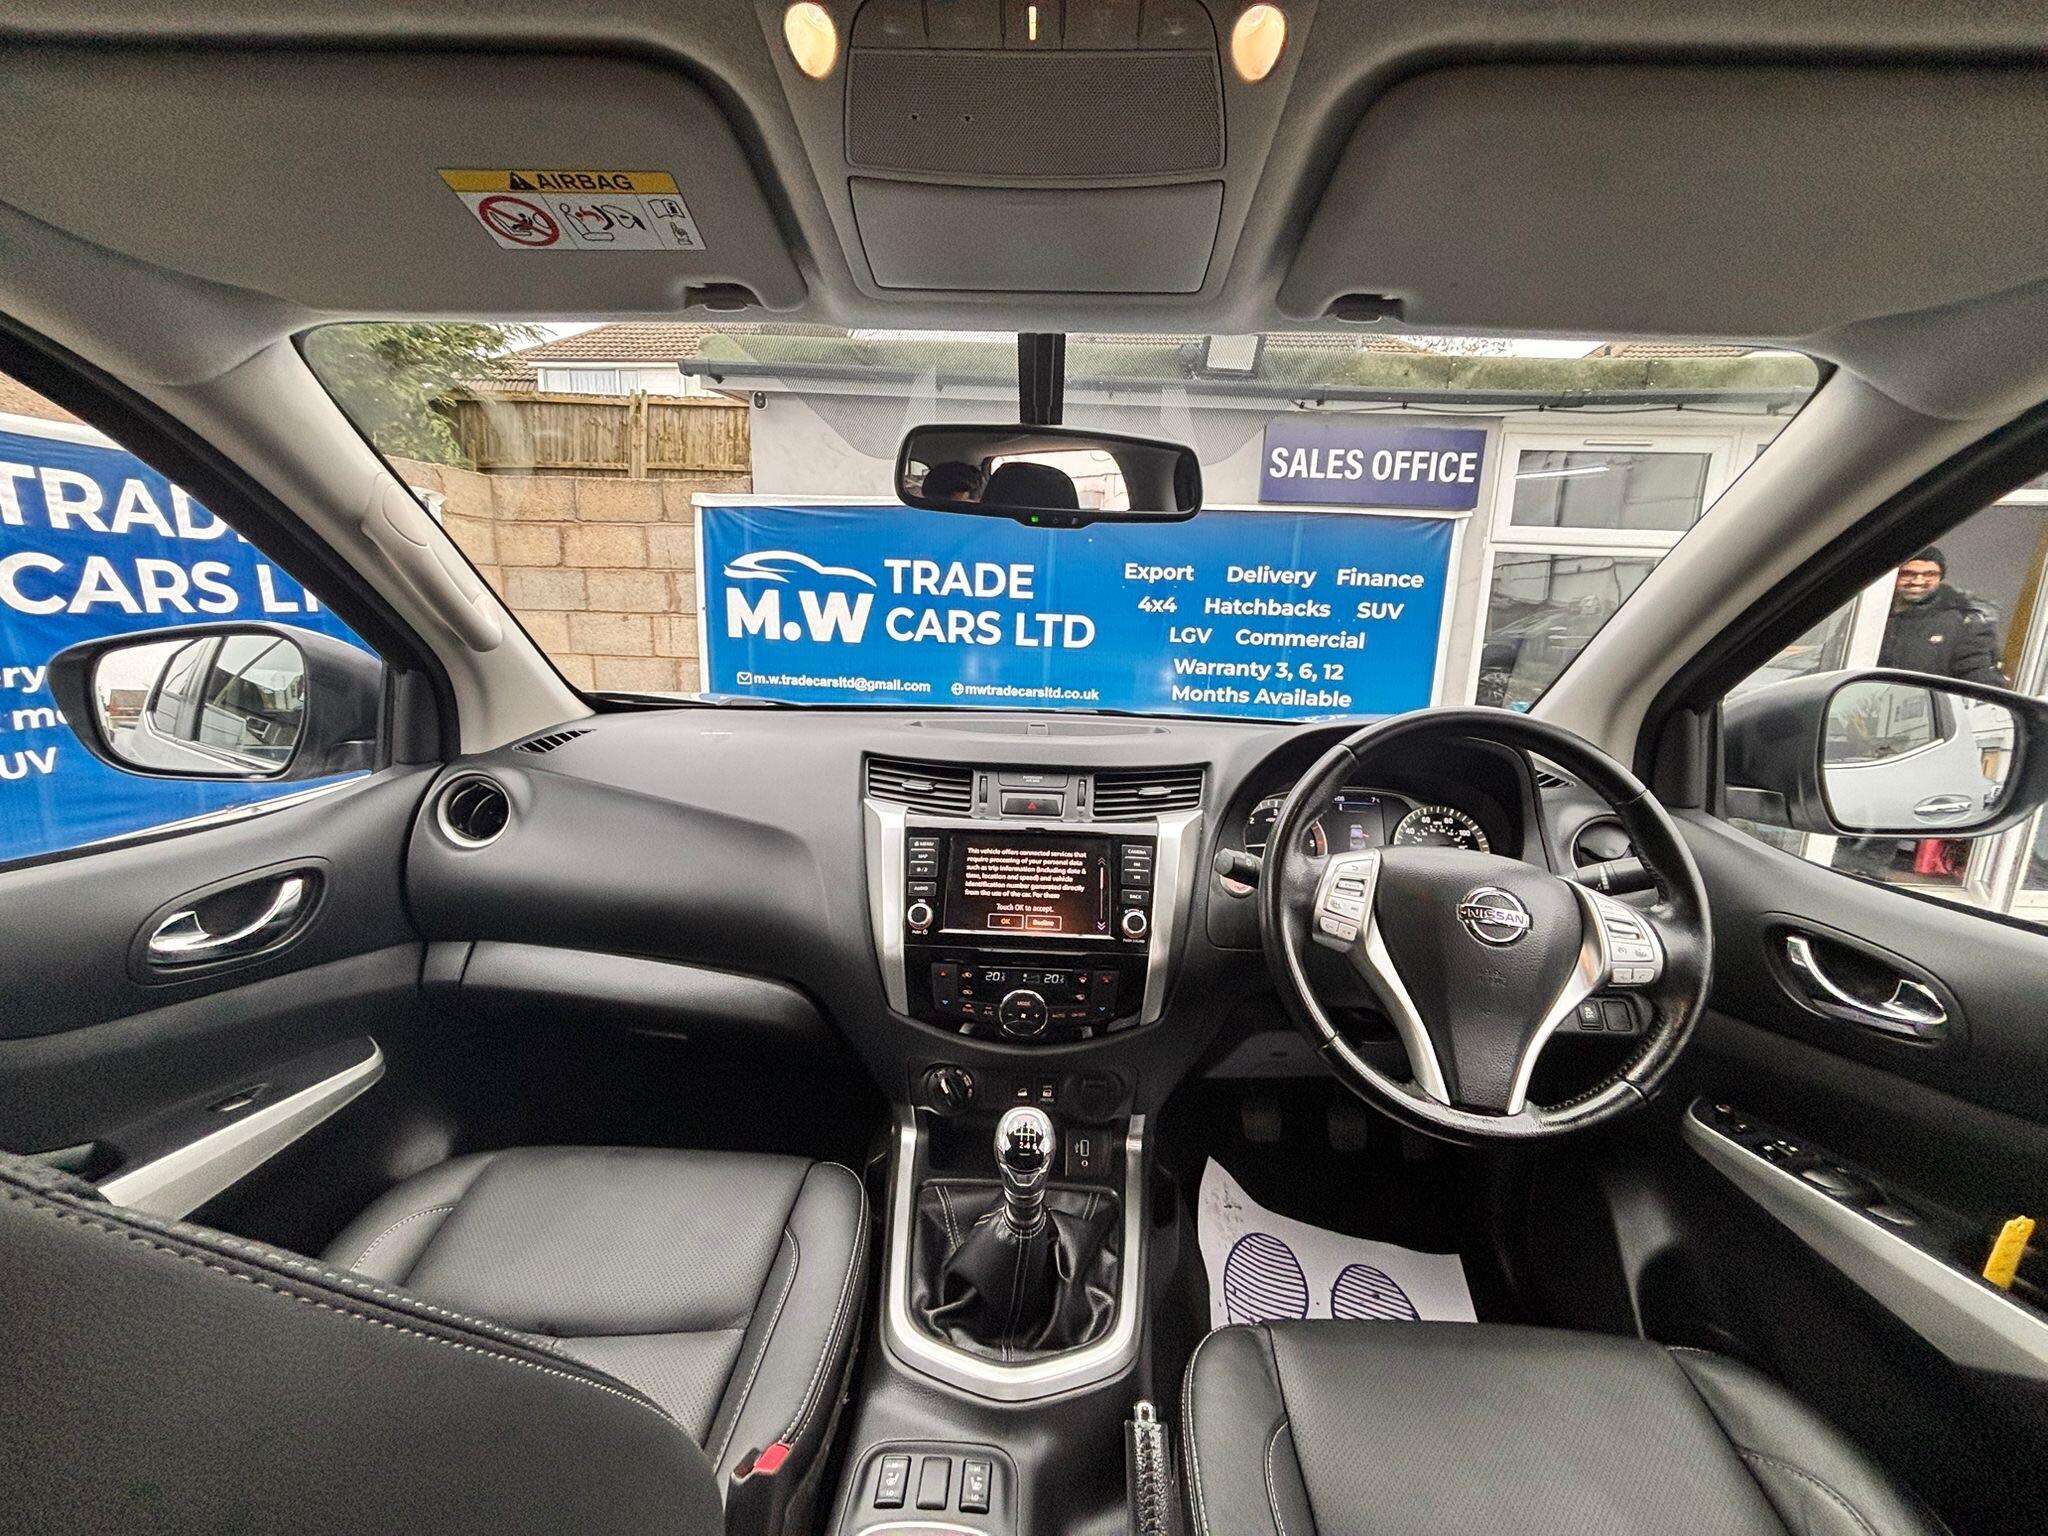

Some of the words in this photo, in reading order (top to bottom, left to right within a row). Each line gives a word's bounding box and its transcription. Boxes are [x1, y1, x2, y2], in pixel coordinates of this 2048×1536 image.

[537, 173, 634, 191] AIRBAG
[1269, 447, 1363, 479] SALES
[1371, 449, 1478, 483] OFFICE
[0, 461, 249, 543] TRAD
[0, 552, 238, 614] CARS
[884, 559, 1035, 600] TRADE
[1124, 563, 1194, 584] Export
[1227, 566, 1317, 588] Delivery
[1337, 568, 1424, 588] Finance
[727, 588, 874, 644] M.W
[1138, 596, 1178, 613] 4x4
[1204, 597, 1331, 618] Hatchbacks
[1356, 602, 1404, 620] SUV
[886, 608, 1001, 646] CARS
[1015, 612, 1096, 648] LTD
[1169, 627, 1213, 644] LGV
[1235, 628, 1366, 650] Commercial
[1174, 658, 1271, 680] Warranty
[1275, 662, 1293, 681] 3,
[1298, 663, 1317, 682] 6,
[1323, 664, 1344, 680] 12
[753, 673, 932, 693] m.w.tradecarsltd@gmail.com
[965, 684, 1100, 700] mwtradecarsltd.co.uk
[1172, 686, 1250, 703] Months
[1254, 688, 1352, 708] Available
[1405, 827, 1415, 835] 40
[1466, 908, 1525, 925] NISSAN
